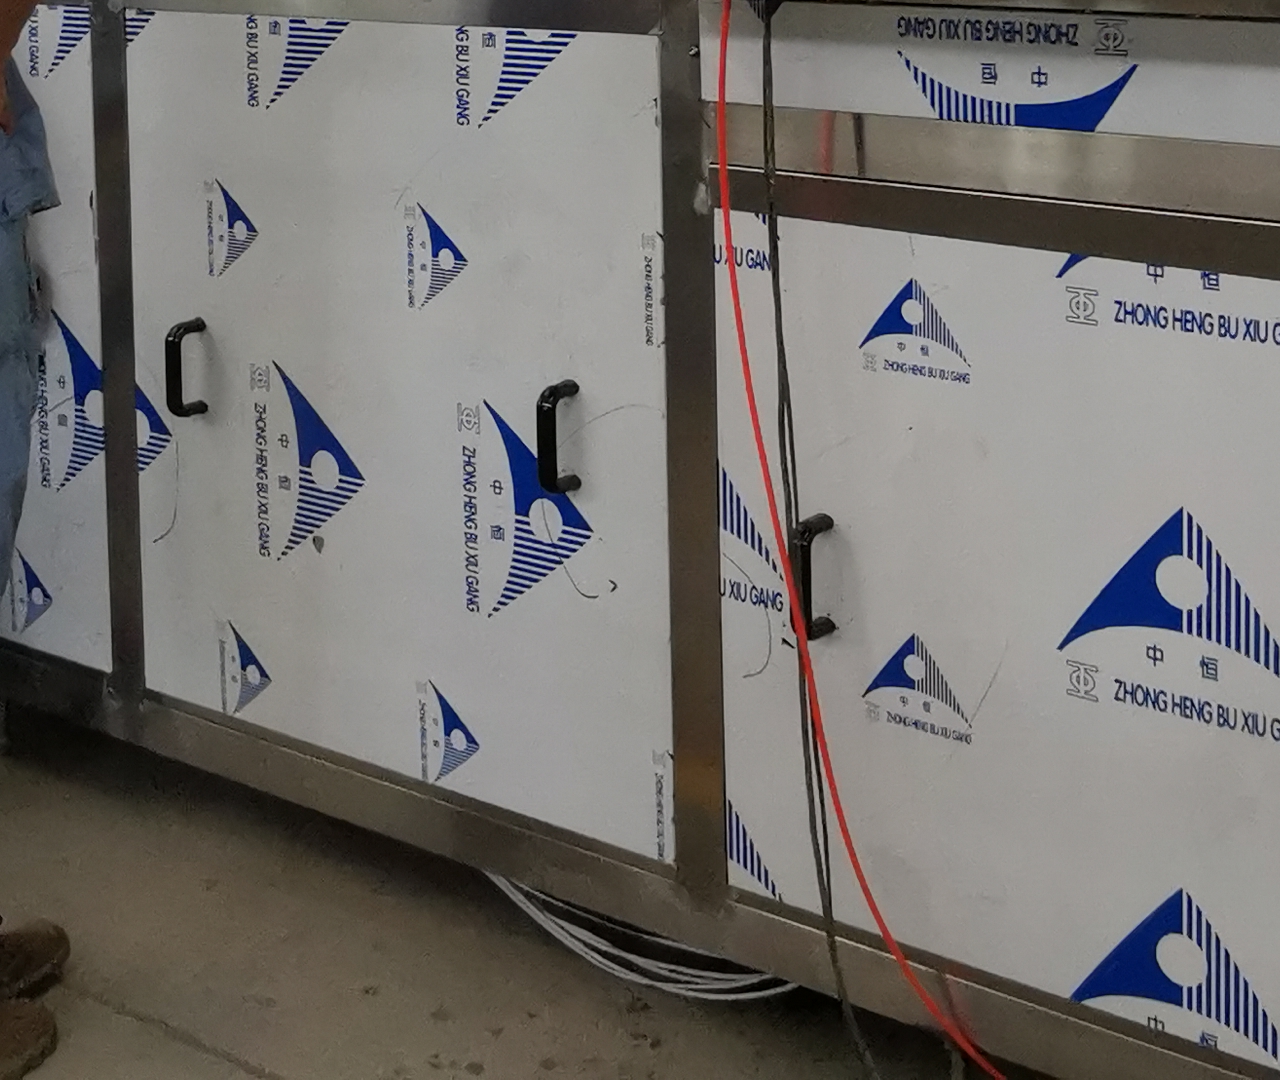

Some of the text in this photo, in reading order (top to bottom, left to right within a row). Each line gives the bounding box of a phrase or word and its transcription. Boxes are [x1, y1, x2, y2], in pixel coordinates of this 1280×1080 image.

[246, 32, 259, 49] BU
[897, 16, 1079, 46] ZHONG HENG BU XIU GANG
[29, 45, 39, 77] GANG
[246, 50, 259, 71] XIU
[455, 44, 470, 62] BU
[247, 72, 260, 108] GANG
[456, 64, 470, 86] XIU
[456, 88, 471, 126] GANG
[746, 248, 771, 271] GAN
[1114, 300, 1169, 329] ZHONG
[1172, 309, 1214, 336] HENG
[1218, 315, 1239, 340] BU
[1242, 317, 1269, 344] XIU
[254, 402, 271, 557] ZHONG HENG BU XIU GANG
[462, 445, 480, 613] ZHONG HENG BU XIU GANG
[729, 579, 747, 603] XIU
[750, 584, 784, 612] GANG
[1114, 678, 1168, 713] ZHONG
[1171, 693, 1213, 724] HENG
[1216, 704, 1238, 731] BU
[1241, 709, 1267, 737] XIU
